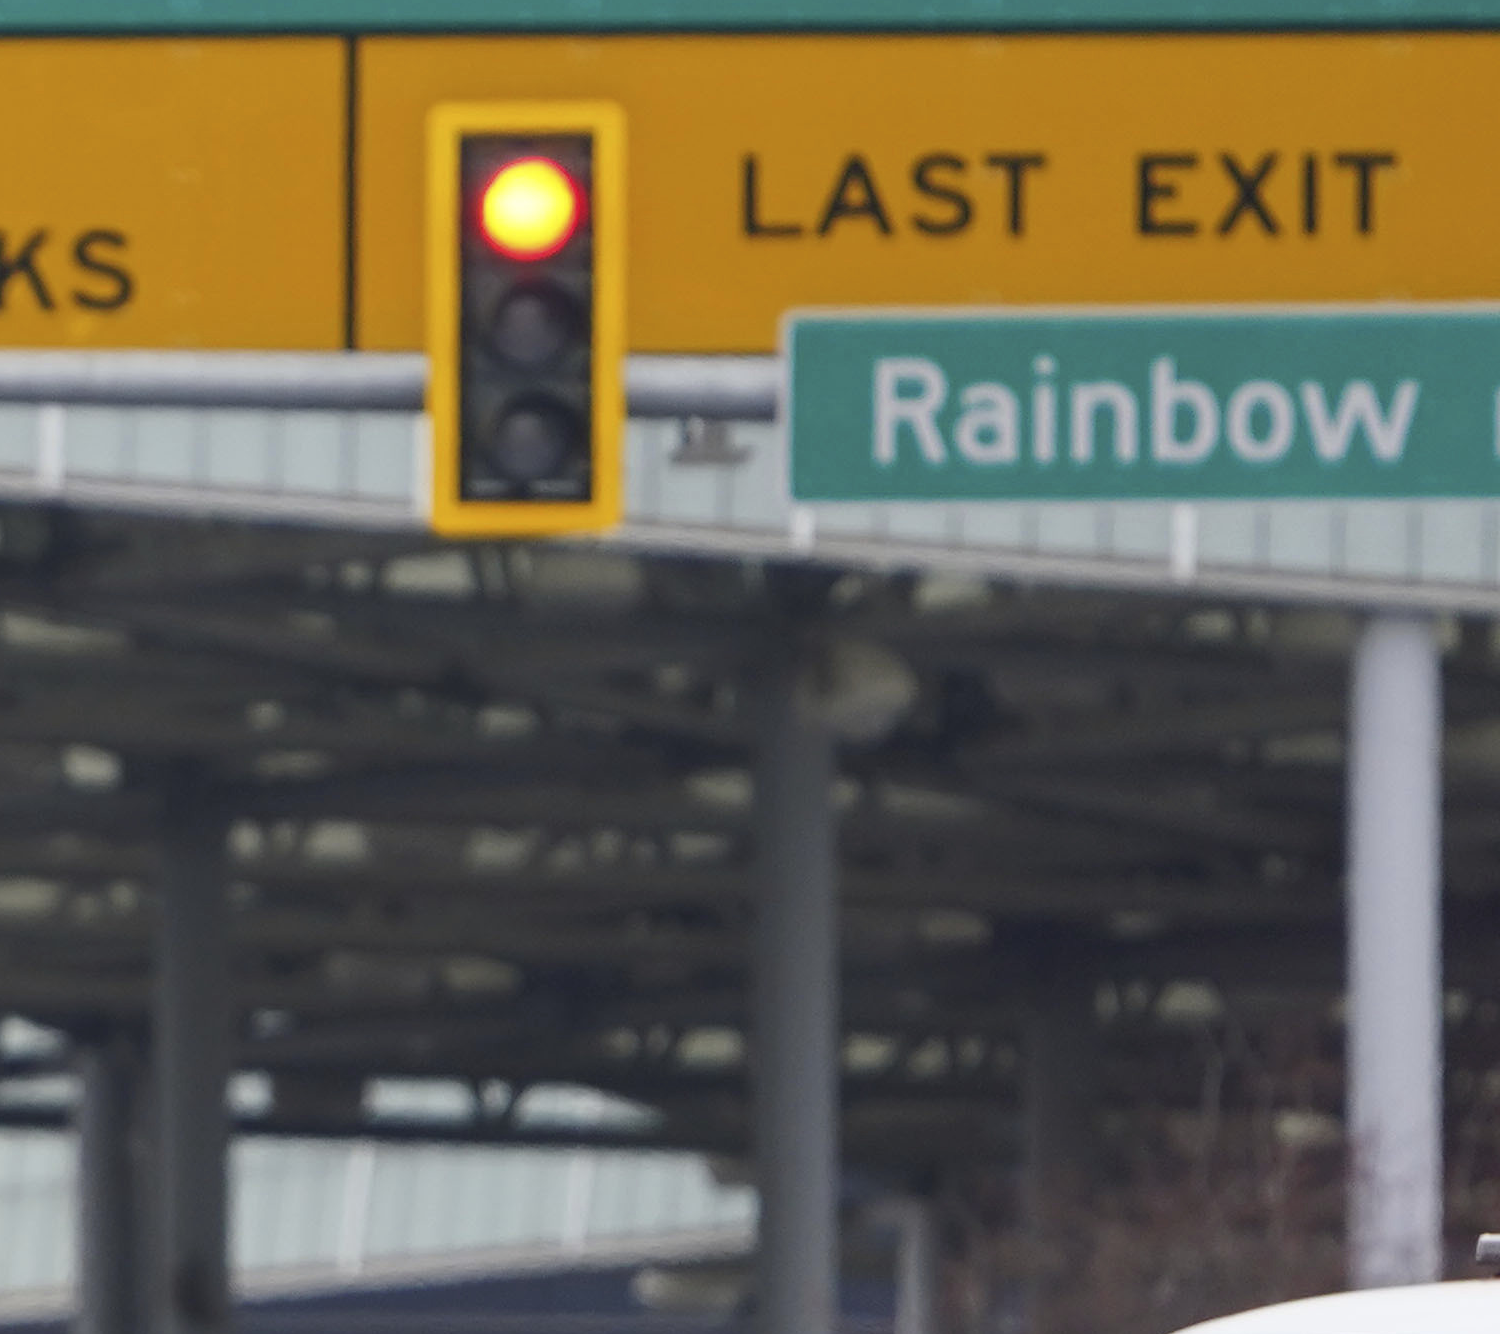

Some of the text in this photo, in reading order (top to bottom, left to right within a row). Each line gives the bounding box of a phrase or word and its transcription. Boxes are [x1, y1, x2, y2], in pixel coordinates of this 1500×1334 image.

[740, 151, 1398, 241] LAST EXIT
[872, 355, 1420, 465] Rainbow
